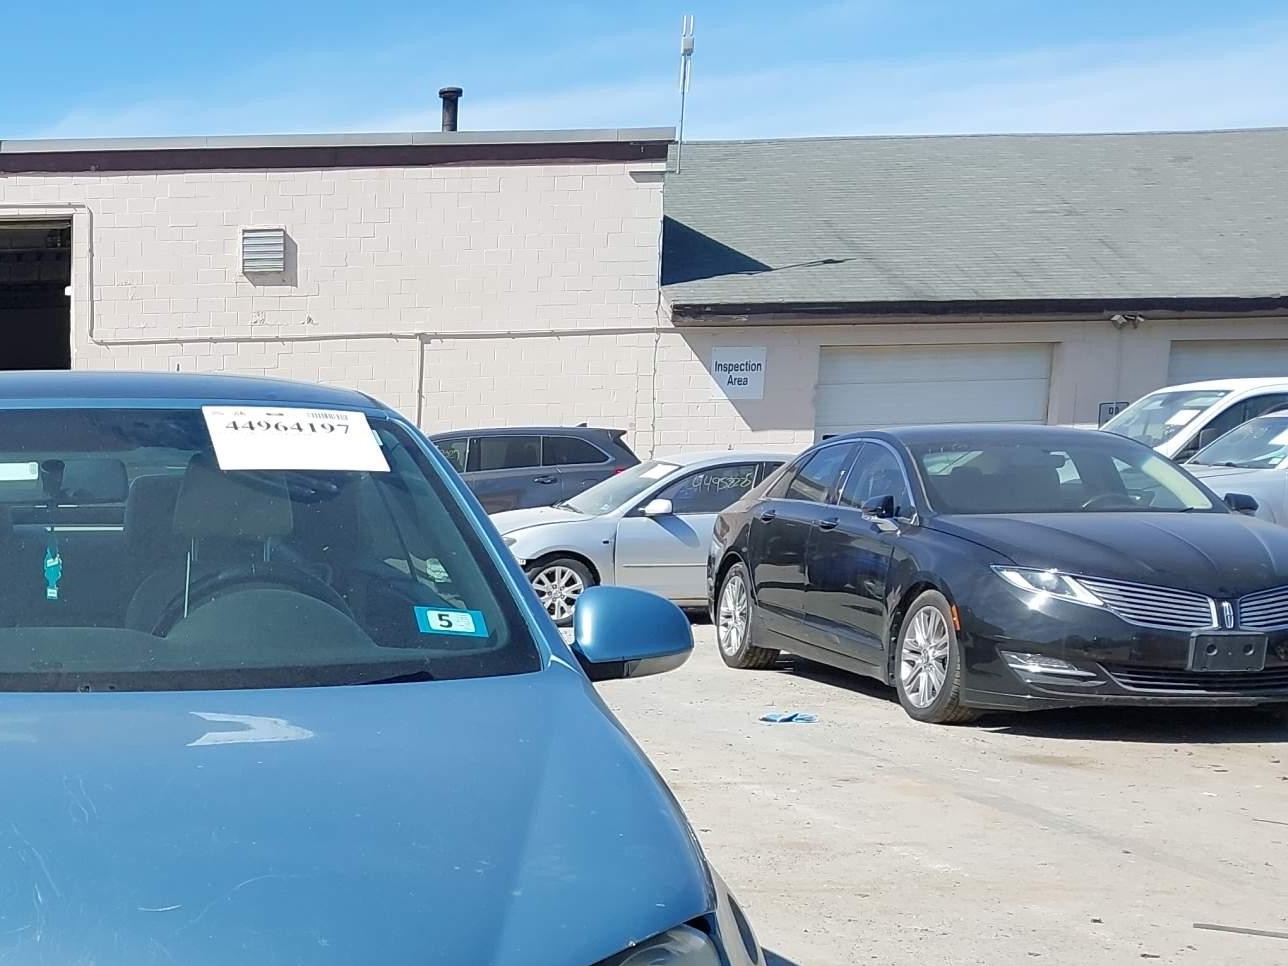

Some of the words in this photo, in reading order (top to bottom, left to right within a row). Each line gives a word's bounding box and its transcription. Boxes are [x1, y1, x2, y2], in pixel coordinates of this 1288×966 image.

[714, 360, 762, 374] Inspection
[727, 375, 748, 386] Area
[225, 420, 349, 434] 44964197
[437, 613, 453, 628] 5
